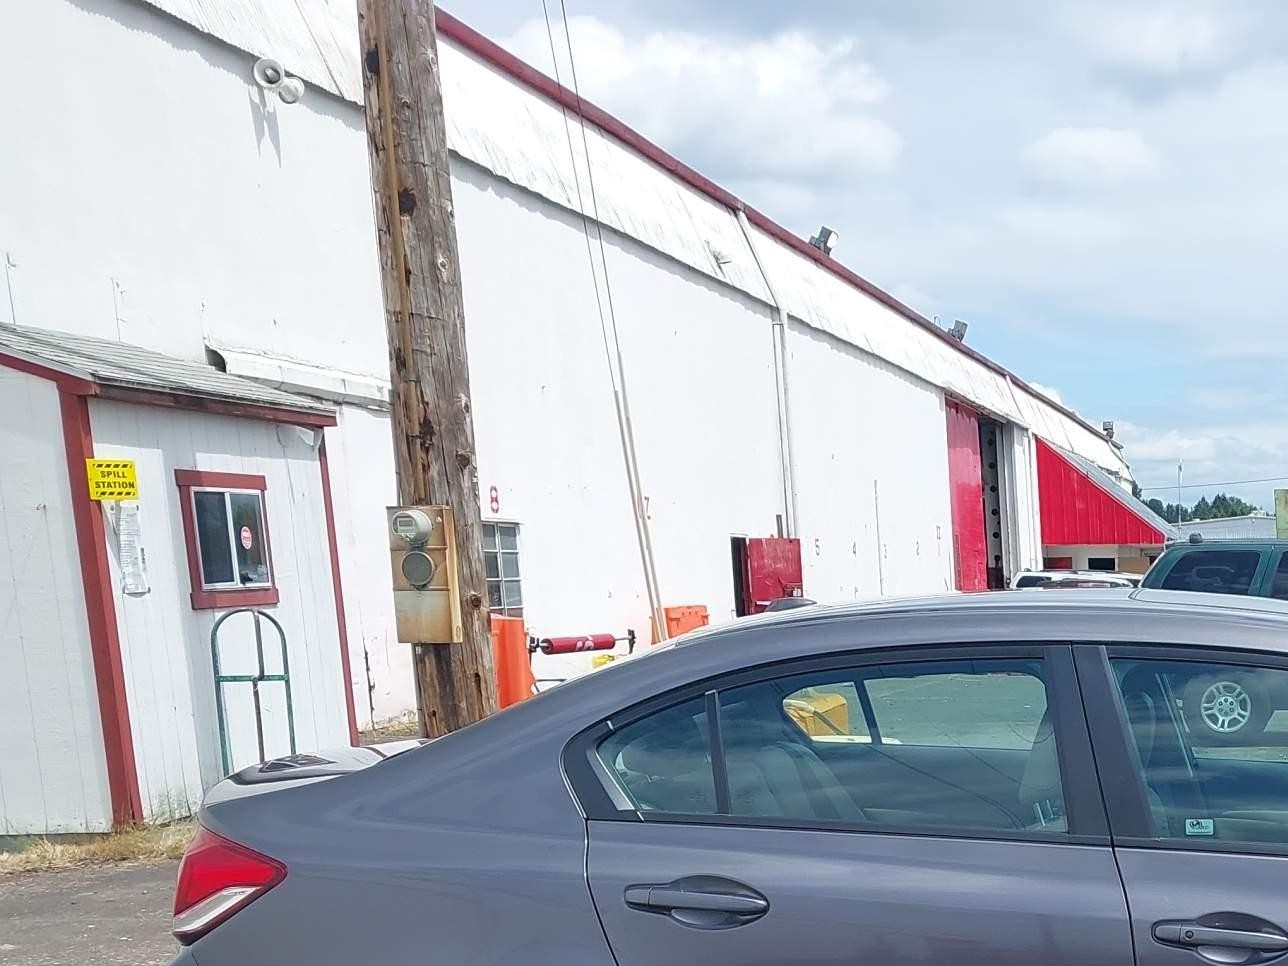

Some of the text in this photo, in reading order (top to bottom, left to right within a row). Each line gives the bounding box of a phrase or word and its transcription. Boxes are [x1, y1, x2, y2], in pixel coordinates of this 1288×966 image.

[100, 470, 127, 479] SPILL
[95, 480, 135, 489] STATION
[489, 485, 500, 514] 8
